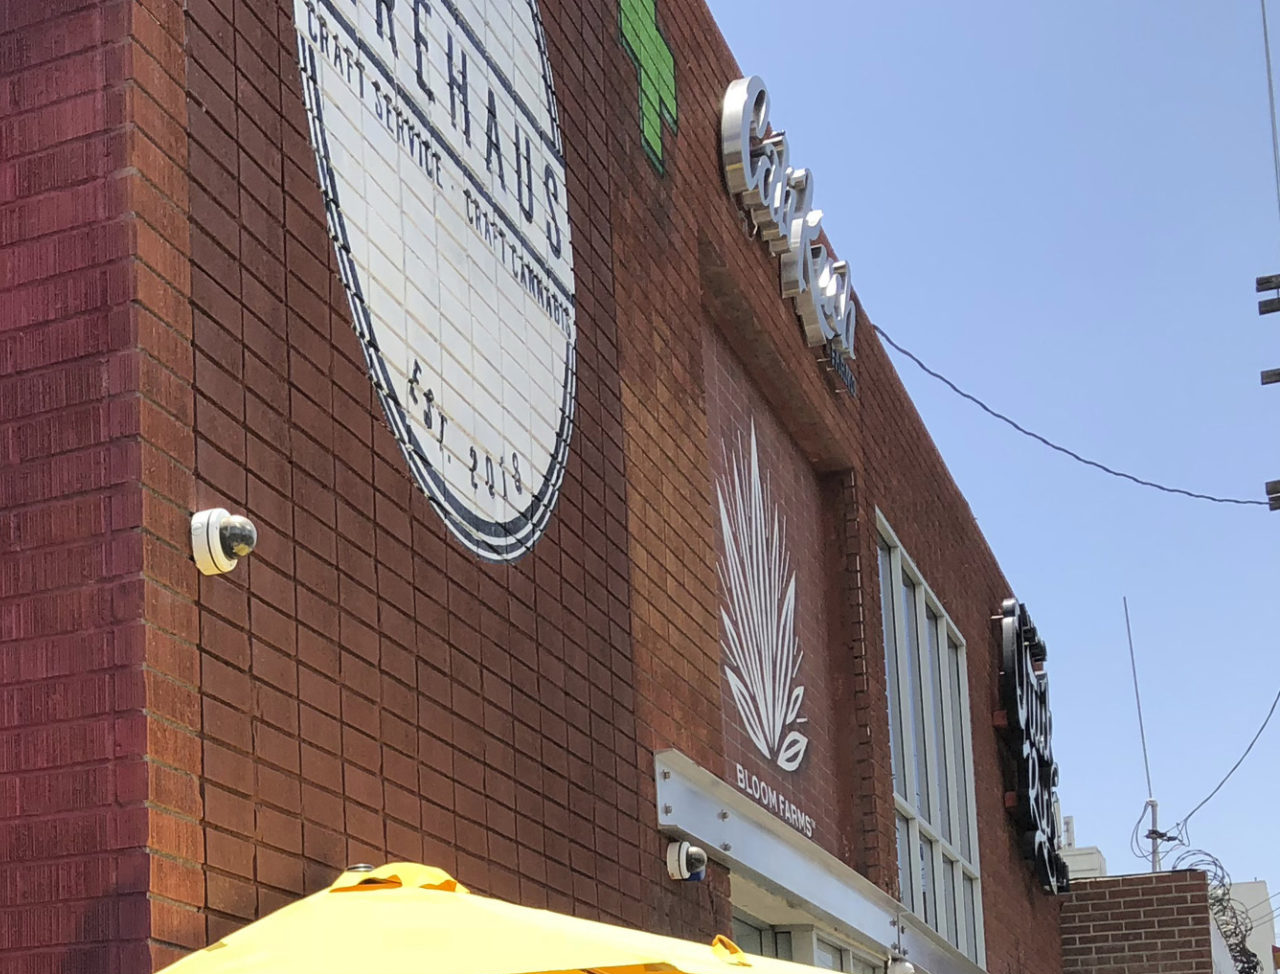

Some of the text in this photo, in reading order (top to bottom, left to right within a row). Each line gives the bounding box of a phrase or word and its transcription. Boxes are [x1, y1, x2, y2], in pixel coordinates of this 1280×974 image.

[304, 0, 365, 99] CRAFT
[371, 79, 443, 190] SERVICE
[463, 188, 506, 264] CRAFT
[350, 0, 562, 259] REHAUS
[470, 446, 522, 500] 2018
[736, 763, 778, 813] BLOOM
